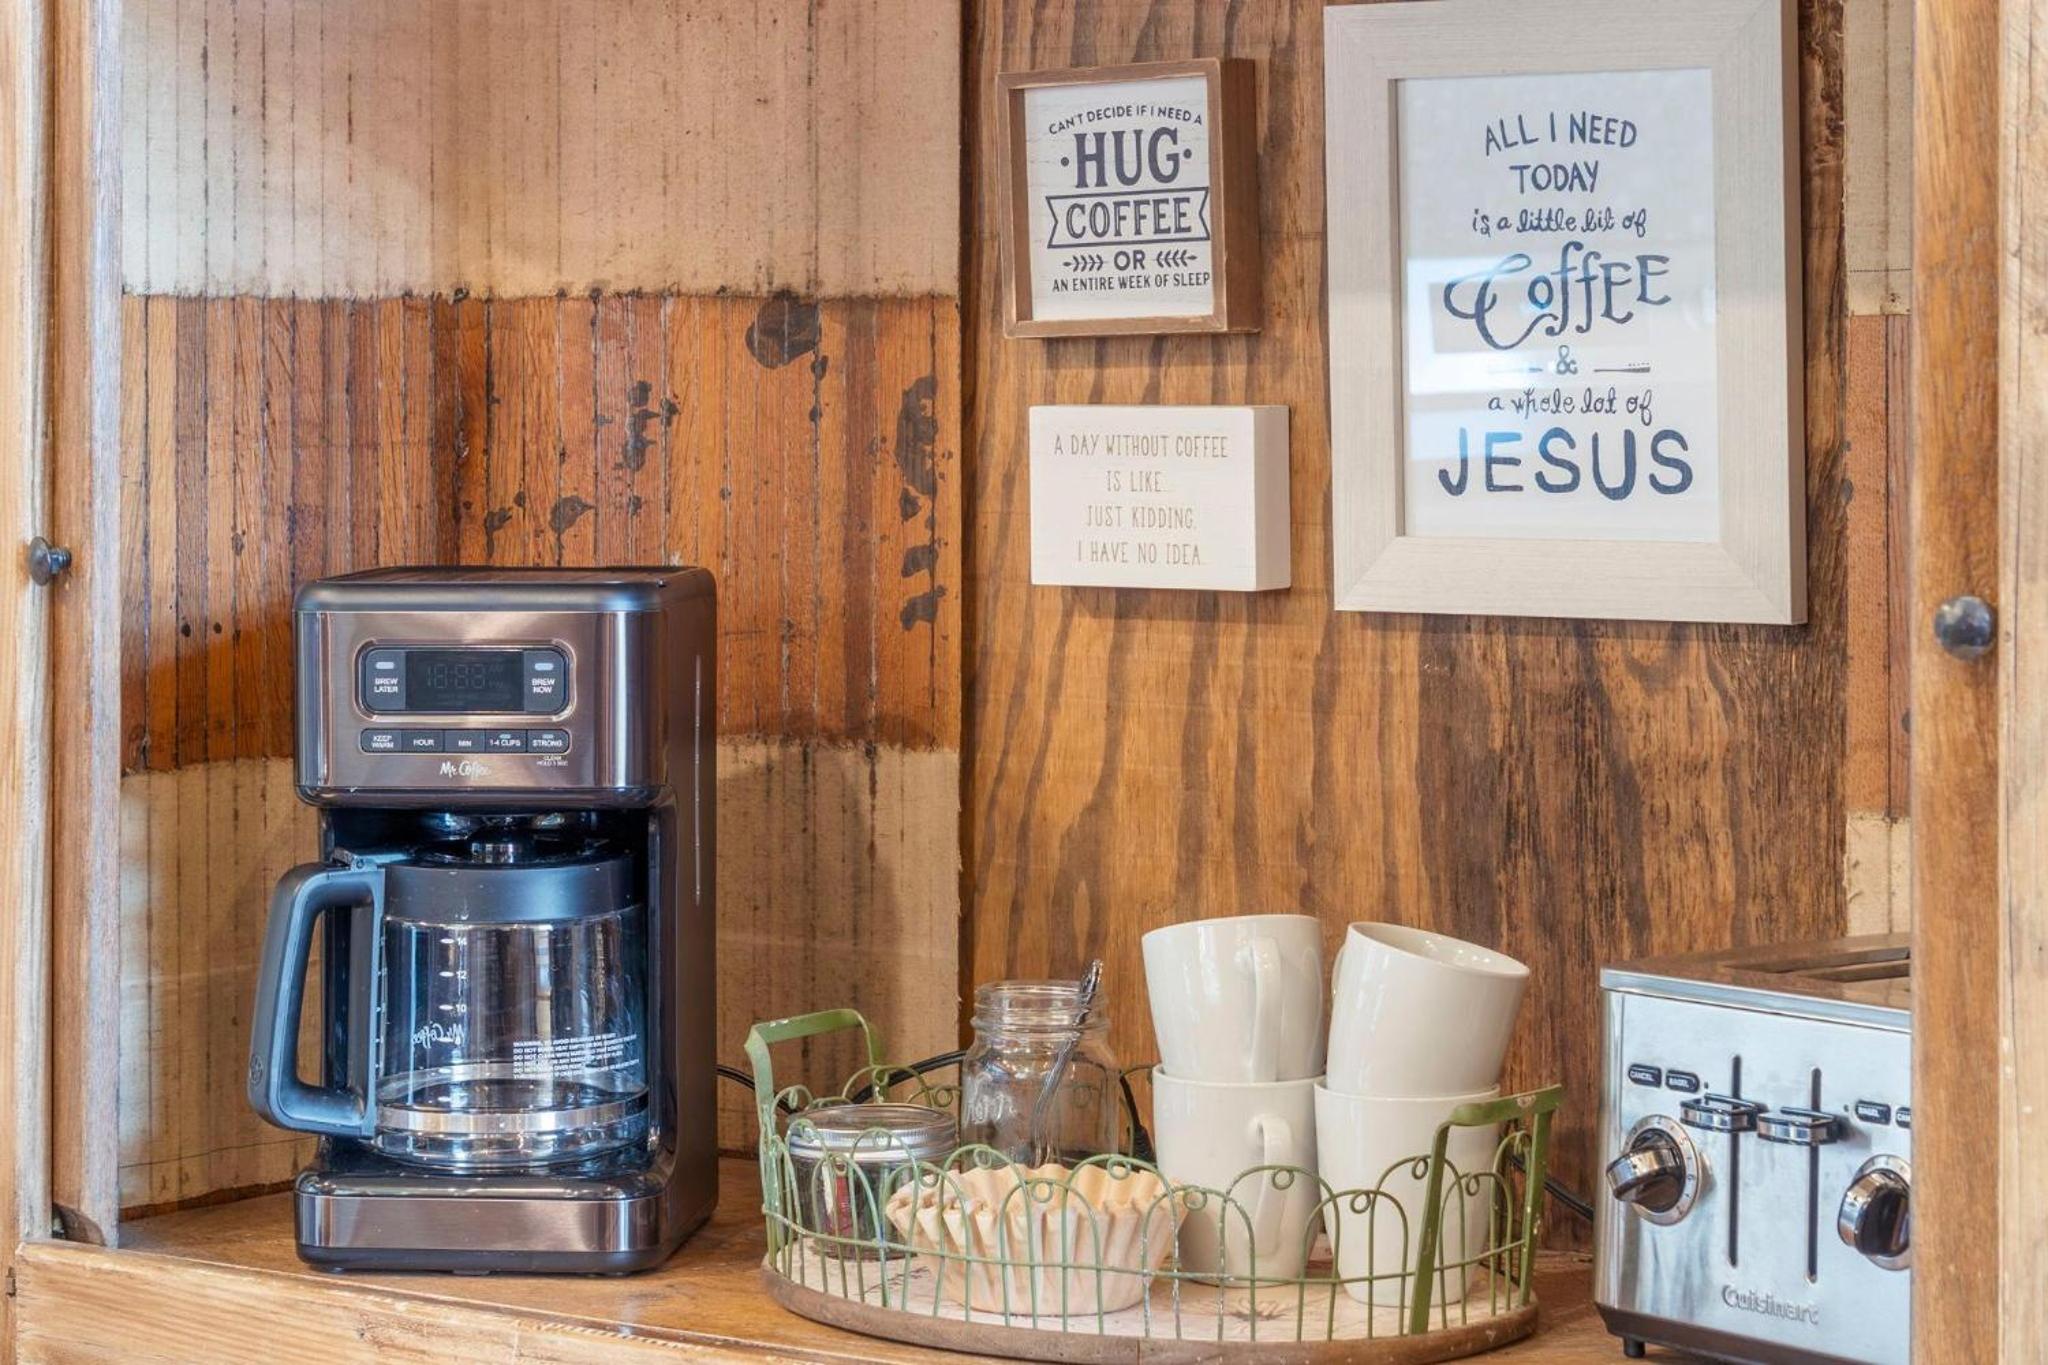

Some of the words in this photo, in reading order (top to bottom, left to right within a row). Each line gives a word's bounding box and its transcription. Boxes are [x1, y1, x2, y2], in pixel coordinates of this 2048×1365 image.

[1086, 105, 1133, 123] DECIDE
[1136, 104, 1147, 116] IF
[1157, 106, 1192, 122] NEED
[1194, 114, 1203, 126] A
[1485, 114, 1539, 157] ALL
[1550, 111, 1556, 143] I
[1569, 111, 1638, 148] NEED
[1073, 126, 1180, 189] HUG
[1509, 160, 1599, 195] TODAY
[1065, 197, 1192, 239] COFFEE
[1472, 208, 1491, 237] is
[1496, 216, 1513, 232] a
[1516, 207, 1578, 233] little
[1580, 206, 1615, 233] bit
[1621, 207, 1648, 239] of
[1113, 250, 1146, 272] OR
[1052, 279, 1069, 292] AN
[1072, 276, 1115, 292] ENTIRE
[1117, 275, 1151, 290] WEEK
[1154, 273, 1169, 288] OF
[1172, 272, 1211, 288] SLEEP
[1555, 344, 1578, 375] &
[1488, 396, 1504, 411] a
[1511, 387, 1575, 420] whole
[1580, 386, 1617, 415] lot
[1625, 388, 1653, 427] of
[1053, 434, 1064, 456] A
[1070, 434, 1100, 456] DAY
[1104, 434, 1170, 458] WITHOUT
[1175, 435, 1229, 459] COFFEE
[1438, 426, 1694, 501] JESUS
[1106, 470, 1121, 493] IS
[1086, 504, 1123, 528] JUST
[1077, 540, 1082, 562] I
[1090, 540, 1129, 563] HAVE
[1137, 541, 1157, 564] NO
[373, 685, 399, 693] LATER
[374, 677, 399, 685] BREW
[531, 678, 556, 686] BREW
[532, 685, 553, 694] NOW
[413, 738, 435, 746] HOUR
[500, 739, 521, 747] CUPS
[532, 739, 563, 747] STRONG
[458, 759, 492, 781] Coffee
[456, 970, 468, 980] 12
[456, 1003, 467, 1013] 10
[1629, 1070, 1656, 1082] CANCEL
